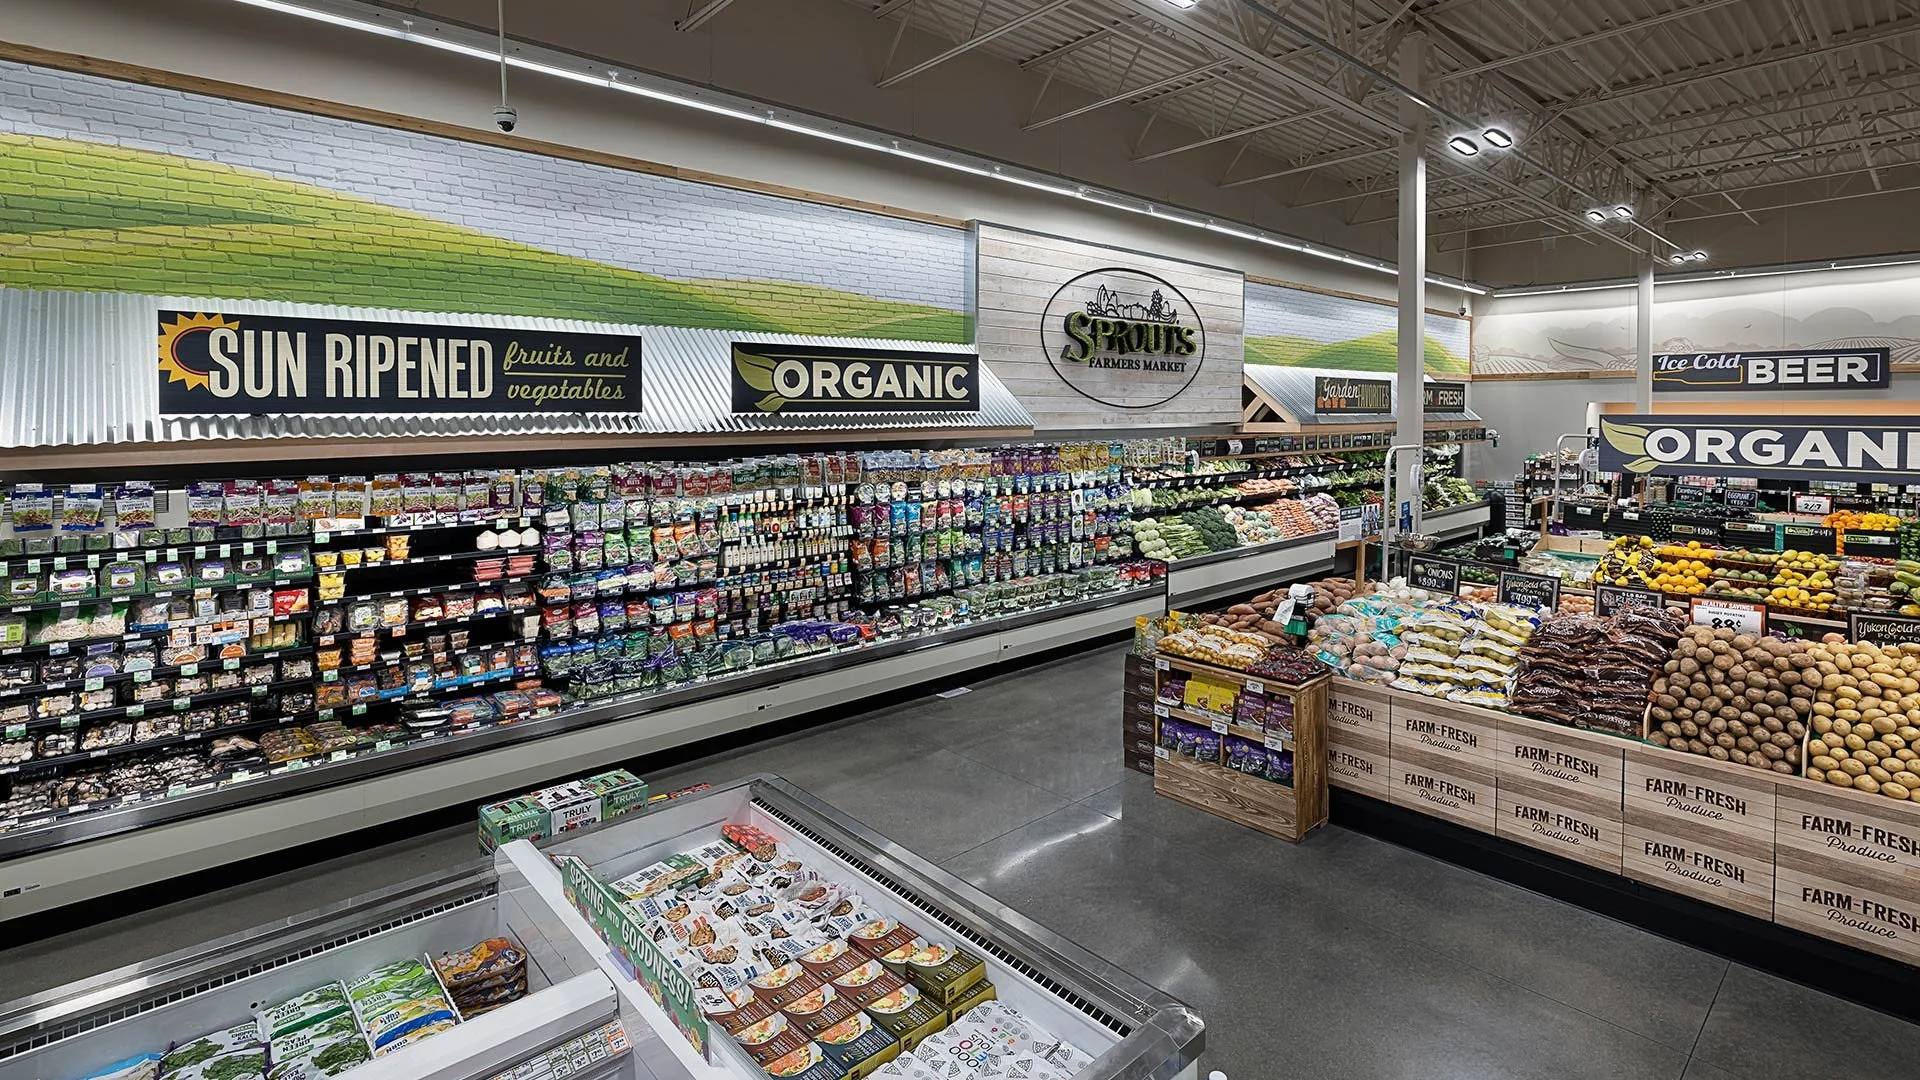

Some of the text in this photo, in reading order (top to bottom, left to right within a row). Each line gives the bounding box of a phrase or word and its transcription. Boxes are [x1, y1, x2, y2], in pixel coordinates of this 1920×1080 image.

[1061, 310, 1197, 363] SPROUTS
[209, 327, 492, 398] SUN RIPENED
[503, 342, 629, 371] fruits and
[1088, 356, 1187, 373] FARMERS MARKET
[1657, 353, 1741, 370] Ice Cold
[771, 359, 970, 399] ORGANIC
[1747, 356, 1869, 384] BEER
[506, 381, 625, 405] vegetables
[1322, 378, 1361, 401] Garden
[1357, 385, 1390, 408] FAVORITES
[1438, 391, 1464, 406] FRESH
[1645, 428, 1920, 470] ORGANI
[1428, 569, 1454, 579] ONIONS
[1524, 580, 1539, 590] Gold
[1701, 600, 1755, 611] HEALTHY SAVINGS
[1858, 622, 1914, 638] Yukon Gold
[1877, 632, 1920, 643] POTATO
[1328, 698, 1373, 723] M-FRESH
[1406, 719, 1478, 748] FARM-FRESH
[1420, 734, 1461, 753] Produce
[1328, 750, 1373, 775] M-FRESH
[1515, 745, 1599, 779] FARM-FRESH
[1531, 761, 1580, 783] Produce
[613, 790, 641, 804] TRULY
[1404, 774, 1476, 805] FARM-FRESH
[1418, 788, 1460, 809] Produce
[1645, 778, 1747, 816] FARM-FRESH
[563, 805, 593, 818] TRULY
[1665, 796, 1724, 821] Produce
[510, 818, 541, 835] TRULY
[1515, 805, 1599, 842] FARM-FRESH
[1531, 822, 1580, 846] Produce
[1826, 835, 1898, 864] Produce
[1644, 841, 1745, 884] FARM-FRESH
[1664, 860, 1723, 888] Produce
[1827, 908, 1898, 940] Produce
[569, 866, 605, 915] SPRING
[606, 909, 621, 928] INTO
[620, 915, 690, 1010] GOODNESS!
[274, 1006, 300, 1020] GREEN
[276, 1002, 296, 1014] PEAS
[283, 1038, 310, 1052] GREEN
[285, 1035, 306, 1046] PEAS
[386, 1038, 408, 1054] CORN
